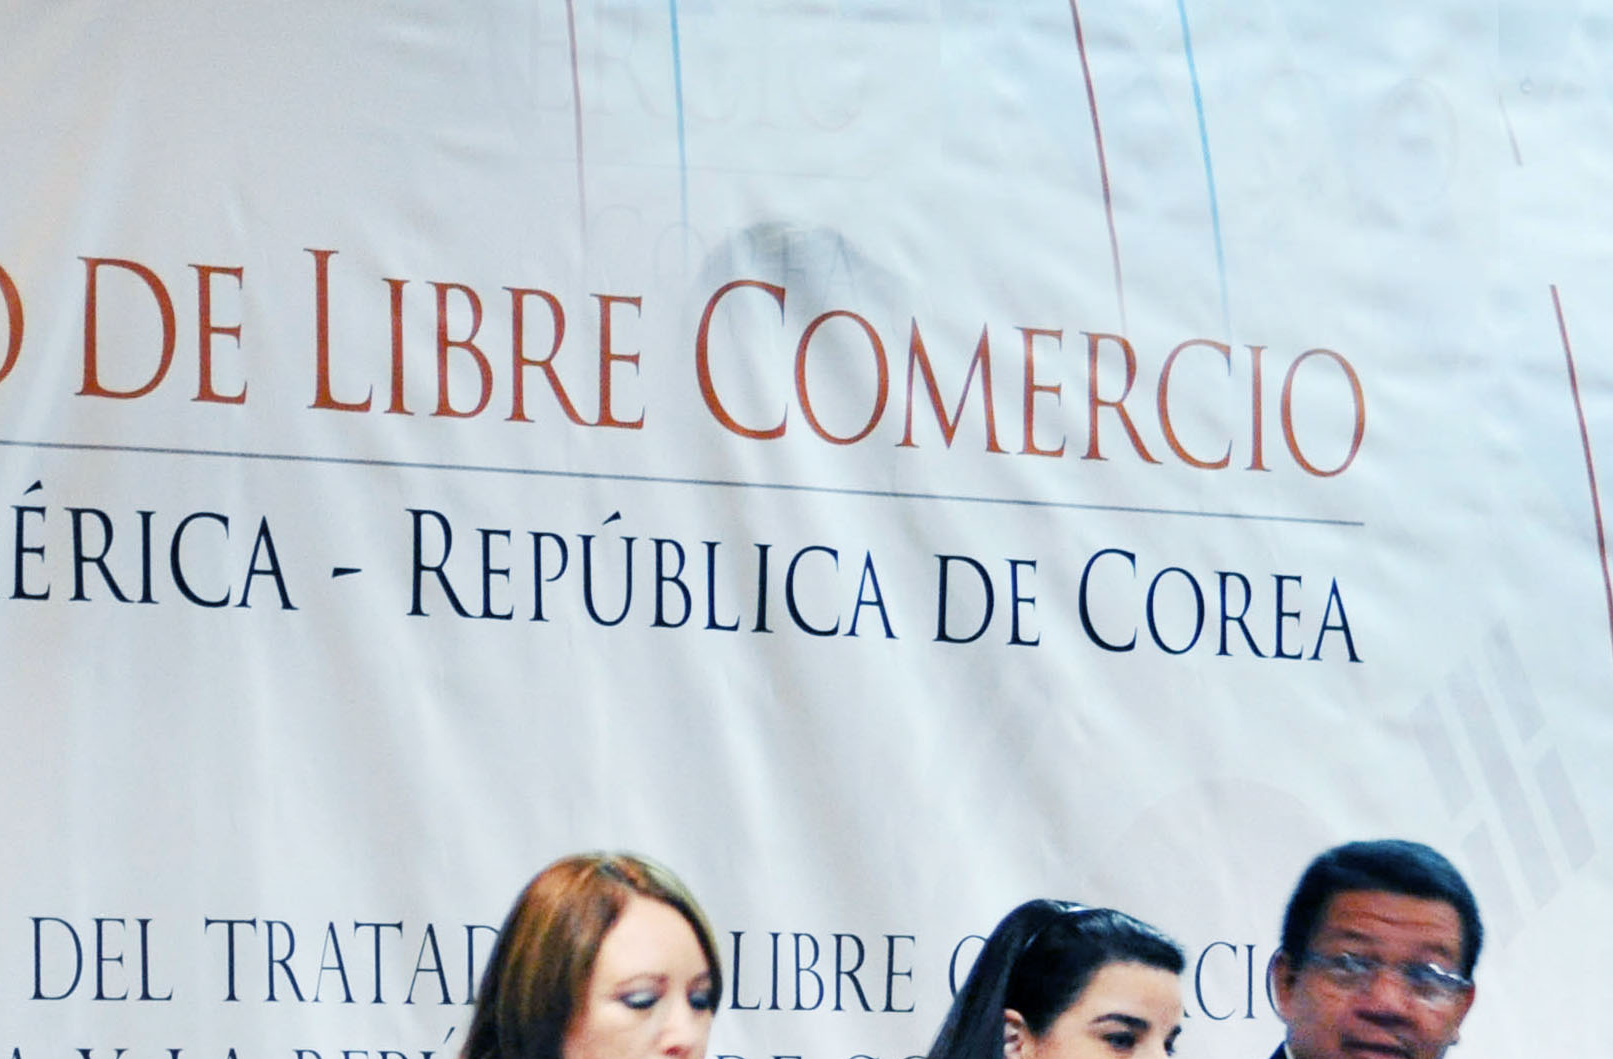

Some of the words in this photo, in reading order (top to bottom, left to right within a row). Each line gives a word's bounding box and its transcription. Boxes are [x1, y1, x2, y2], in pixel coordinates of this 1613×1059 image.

[74, 257, 247, 405] DE
[303, 248, 645, 430] LIBRE
[695, 279, 1365, 478] COMERCIO
[331, 567, 362, 579] -
[405, 508, 899, 640] REPÚBLICA
[933, 554, 1040, 647] DE
[1078, 548, 1364, 663] COREA
[29, 915, 173, 1001] DEL
[728, 931, 916, 1013] LIBRE
